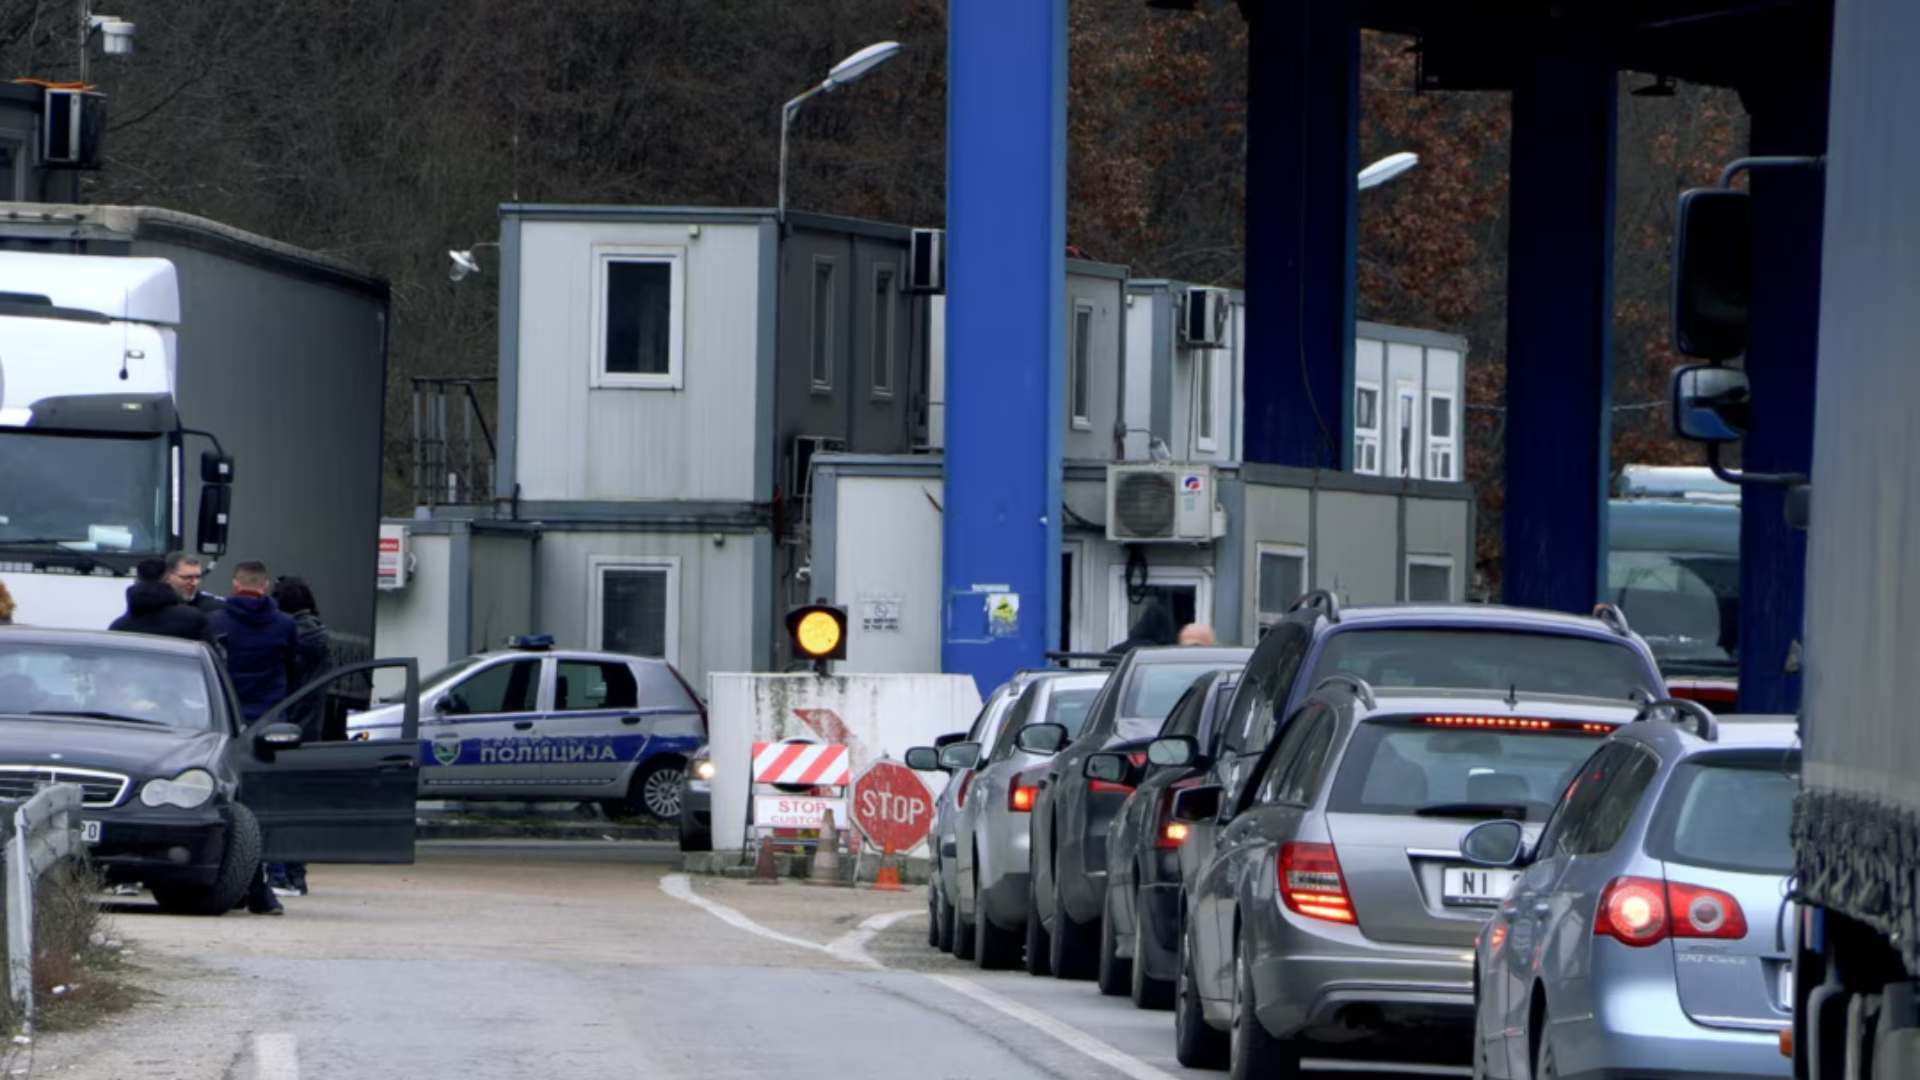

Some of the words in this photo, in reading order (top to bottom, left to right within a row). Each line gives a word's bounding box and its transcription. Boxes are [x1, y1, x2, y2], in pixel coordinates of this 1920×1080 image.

[481, 745, 617, 763] ПОЛИЦИЈА
[778, 800, 826, 813] STOP
[862, 789, 925, 826] STOP
[771, 815, 824, 826] CUSTOM
